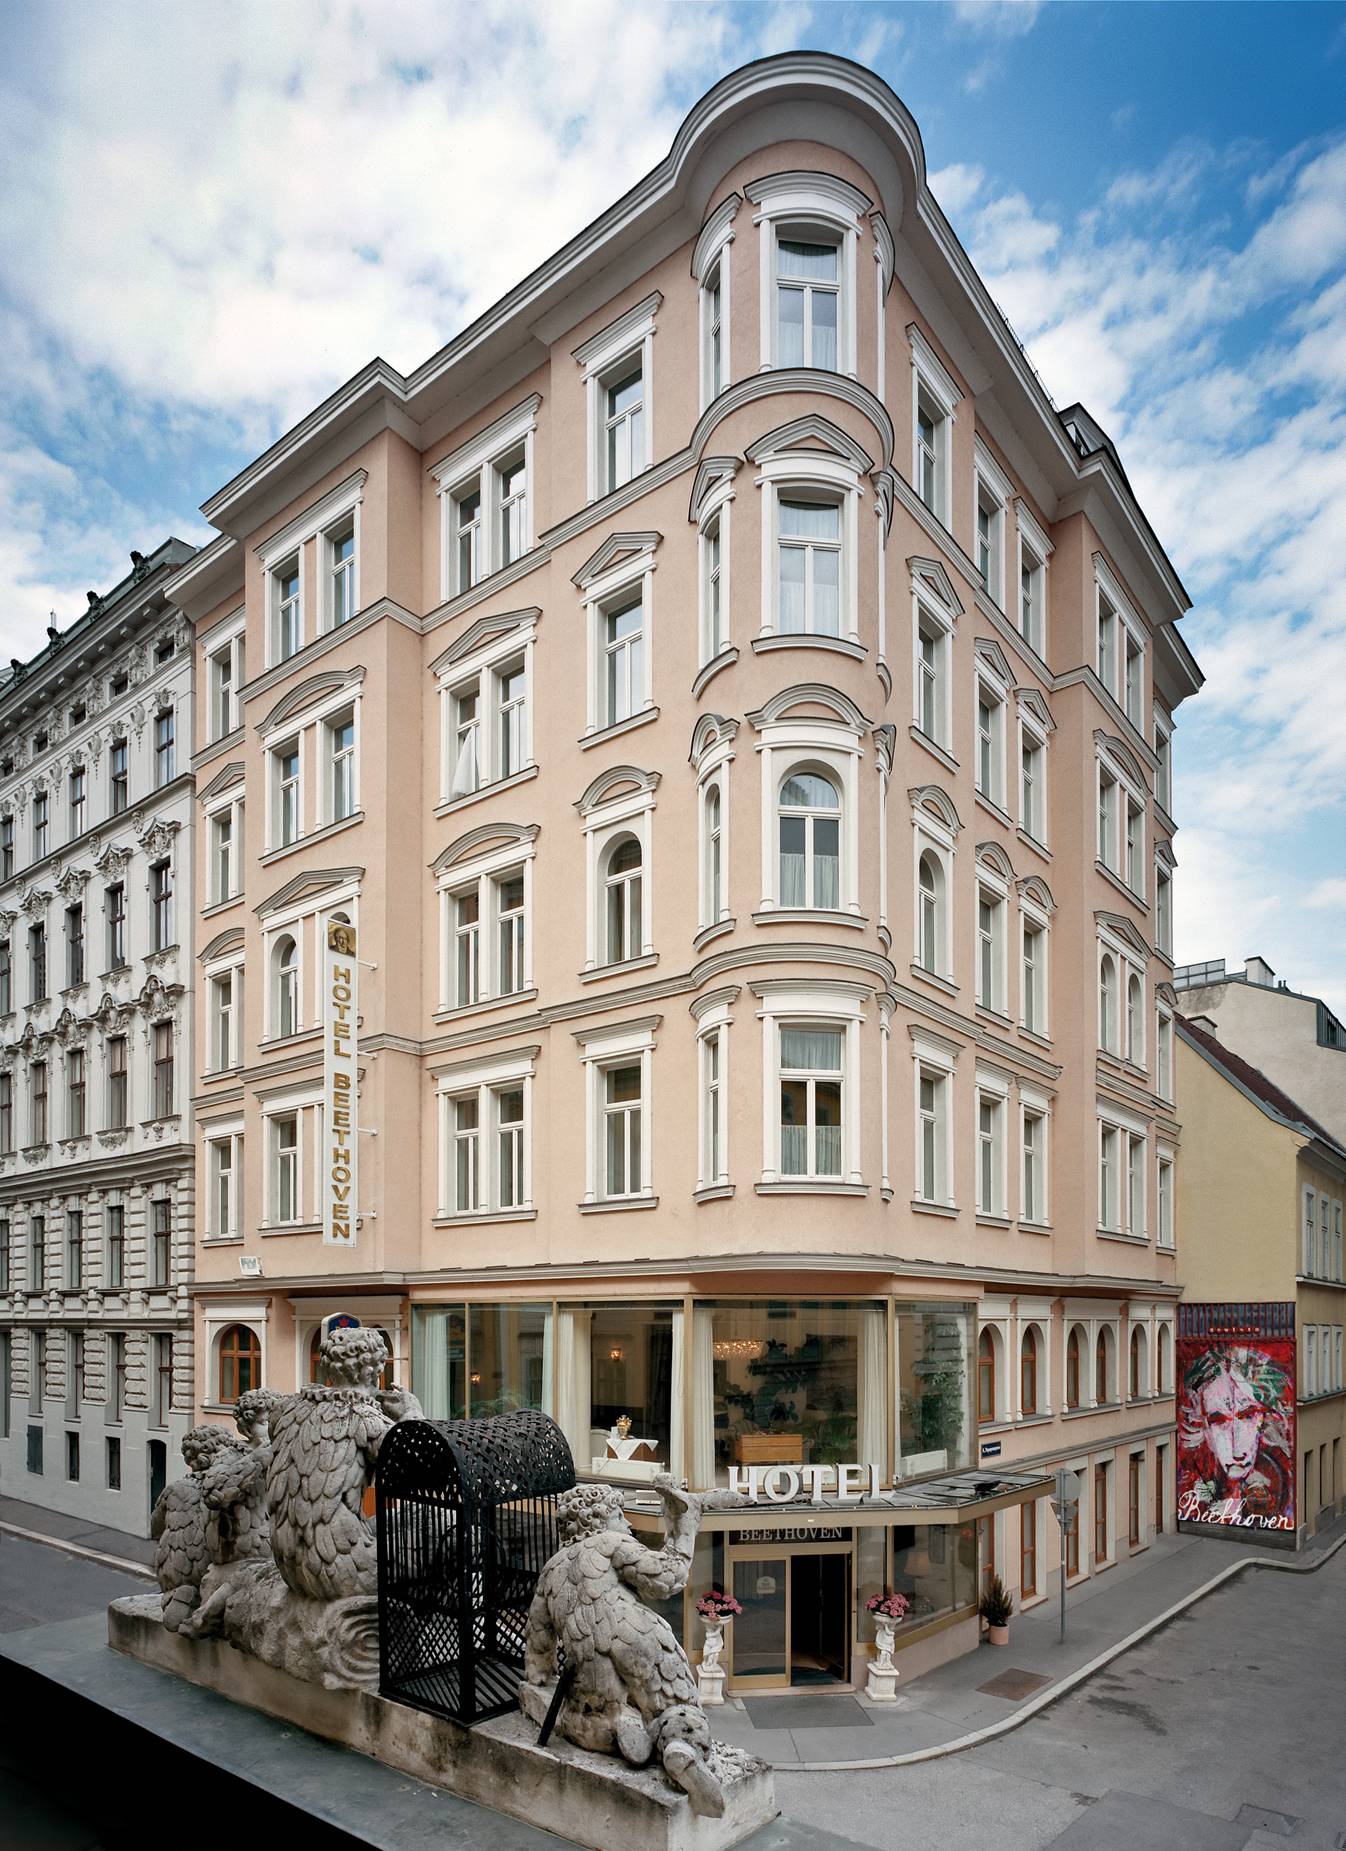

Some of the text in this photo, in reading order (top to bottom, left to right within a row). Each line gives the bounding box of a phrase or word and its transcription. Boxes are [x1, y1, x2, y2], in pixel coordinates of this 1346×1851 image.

[332, 965, 351, 1238] HOTEL BEETHOVEN
[728, 1463, 894, 1502] HOTEL
[1178, 1489, 1294, 1530] Beethoven
[739, 1527, 842, 1541] BEETHOVEN
